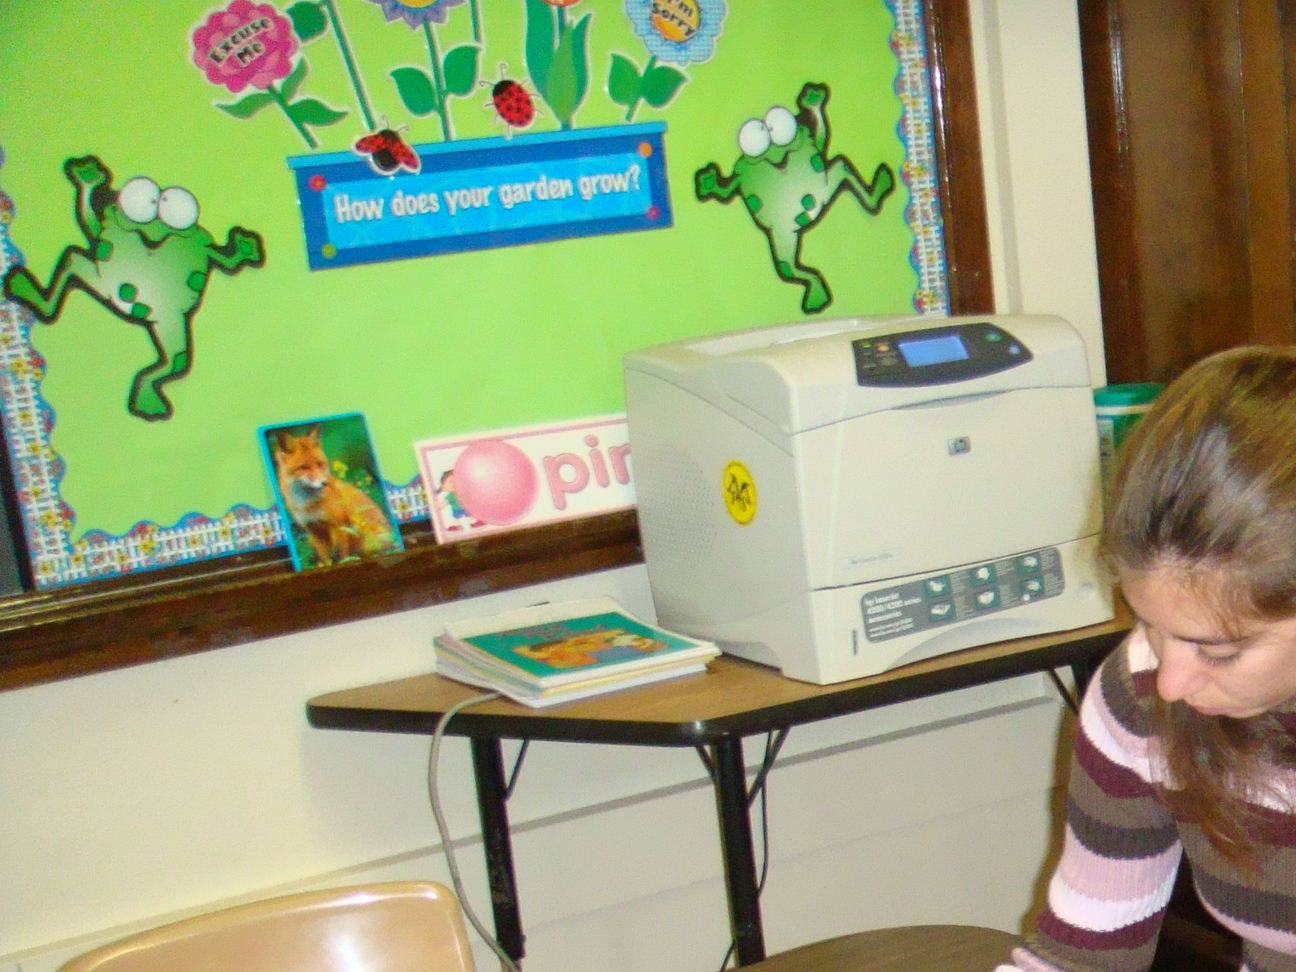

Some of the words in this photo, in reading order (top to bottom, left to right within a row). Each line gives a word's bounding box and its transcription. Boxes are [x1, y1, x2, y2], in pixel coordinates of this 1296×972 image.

[333, 193, 384, 224] How
[391, 190, 439, 217] does
[443, 184, 493, 215] your
[499, 174, 574, 210] garden
[578, 164, 641, 201] grow?
